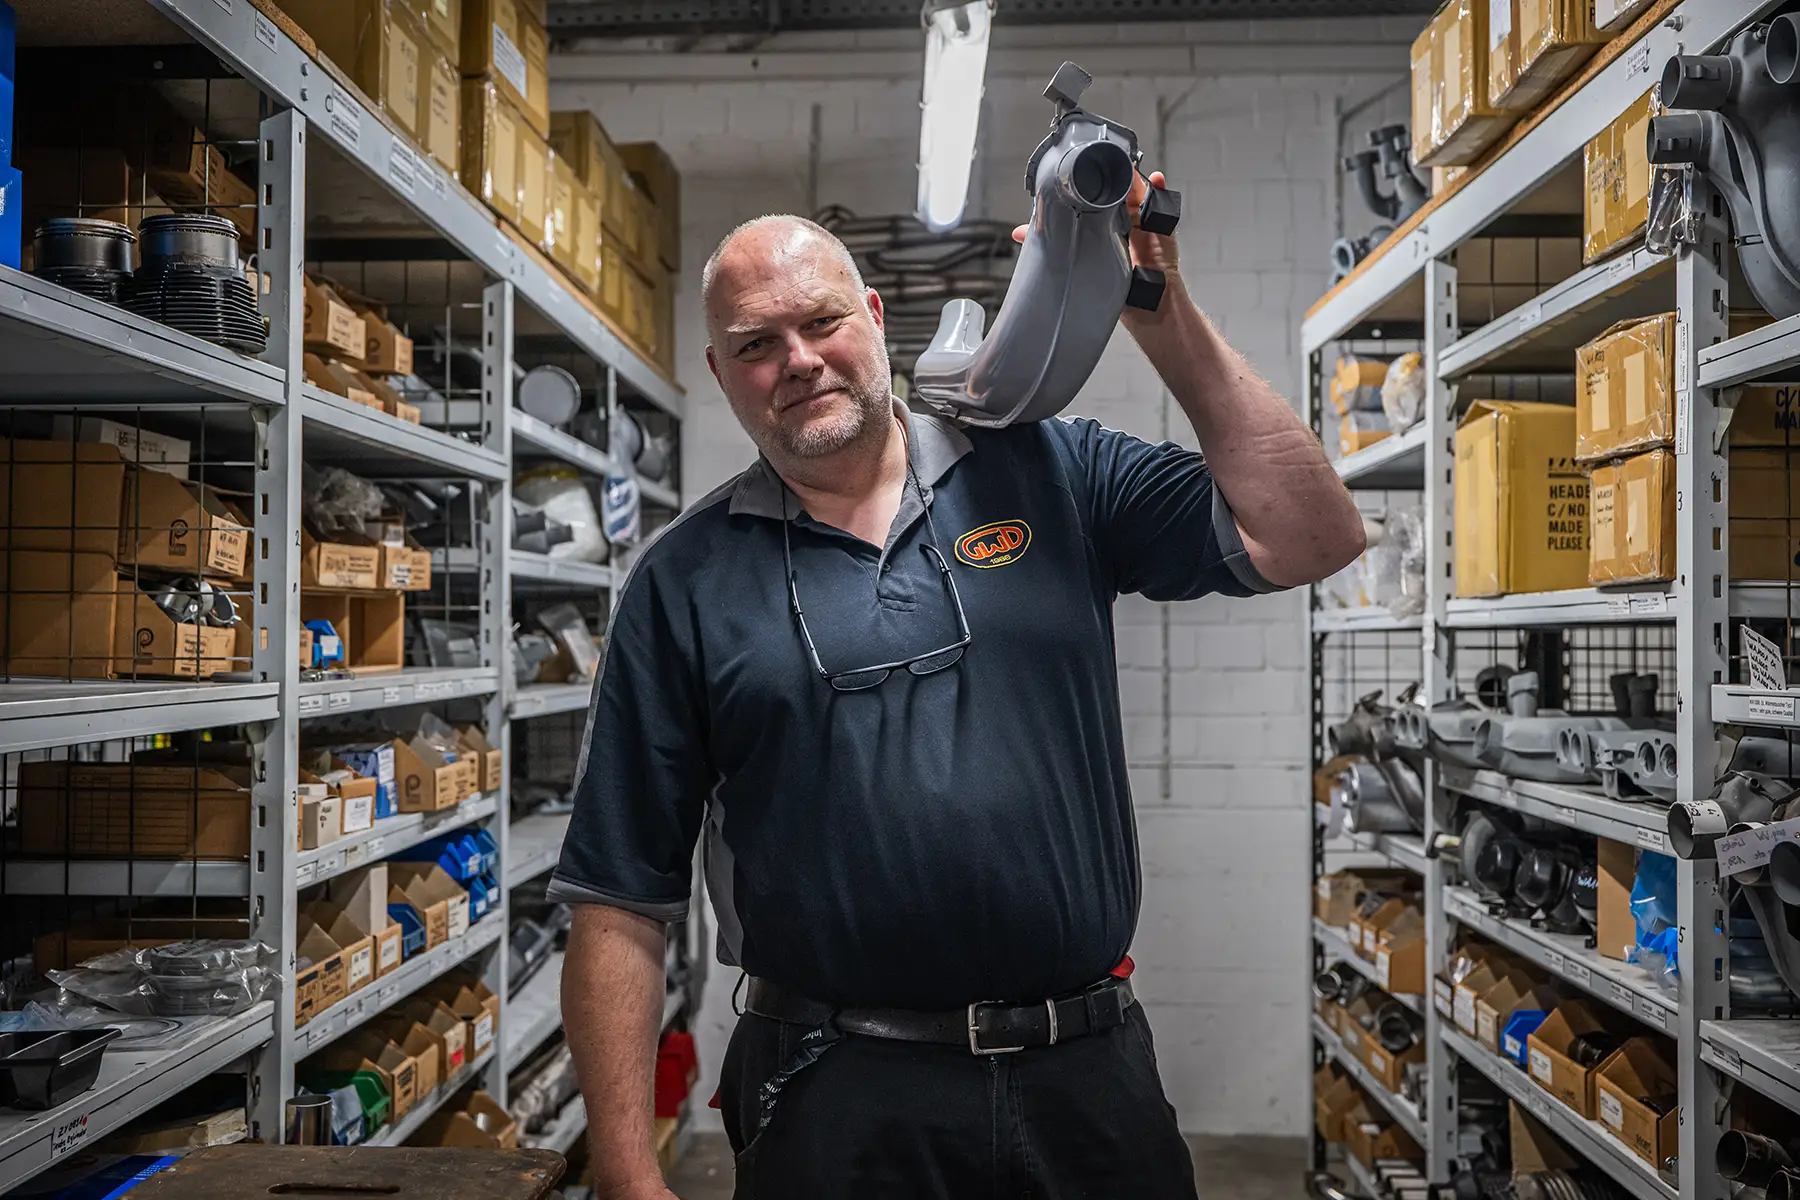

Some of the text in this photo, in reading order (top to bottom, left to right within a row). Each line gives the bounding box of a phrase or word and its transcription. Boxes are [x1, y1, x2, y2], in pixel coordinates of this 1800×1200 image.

[1677, 491, 1683, 511] 3
[1548, 520, 1583, 534] MADE
[1547, 536, 1582, 551] PLEASE
[292, 790, 297, 806] 3
[1678, 925, 1686, 943] 5
[1679, 1106, 1685, 1126] 6
